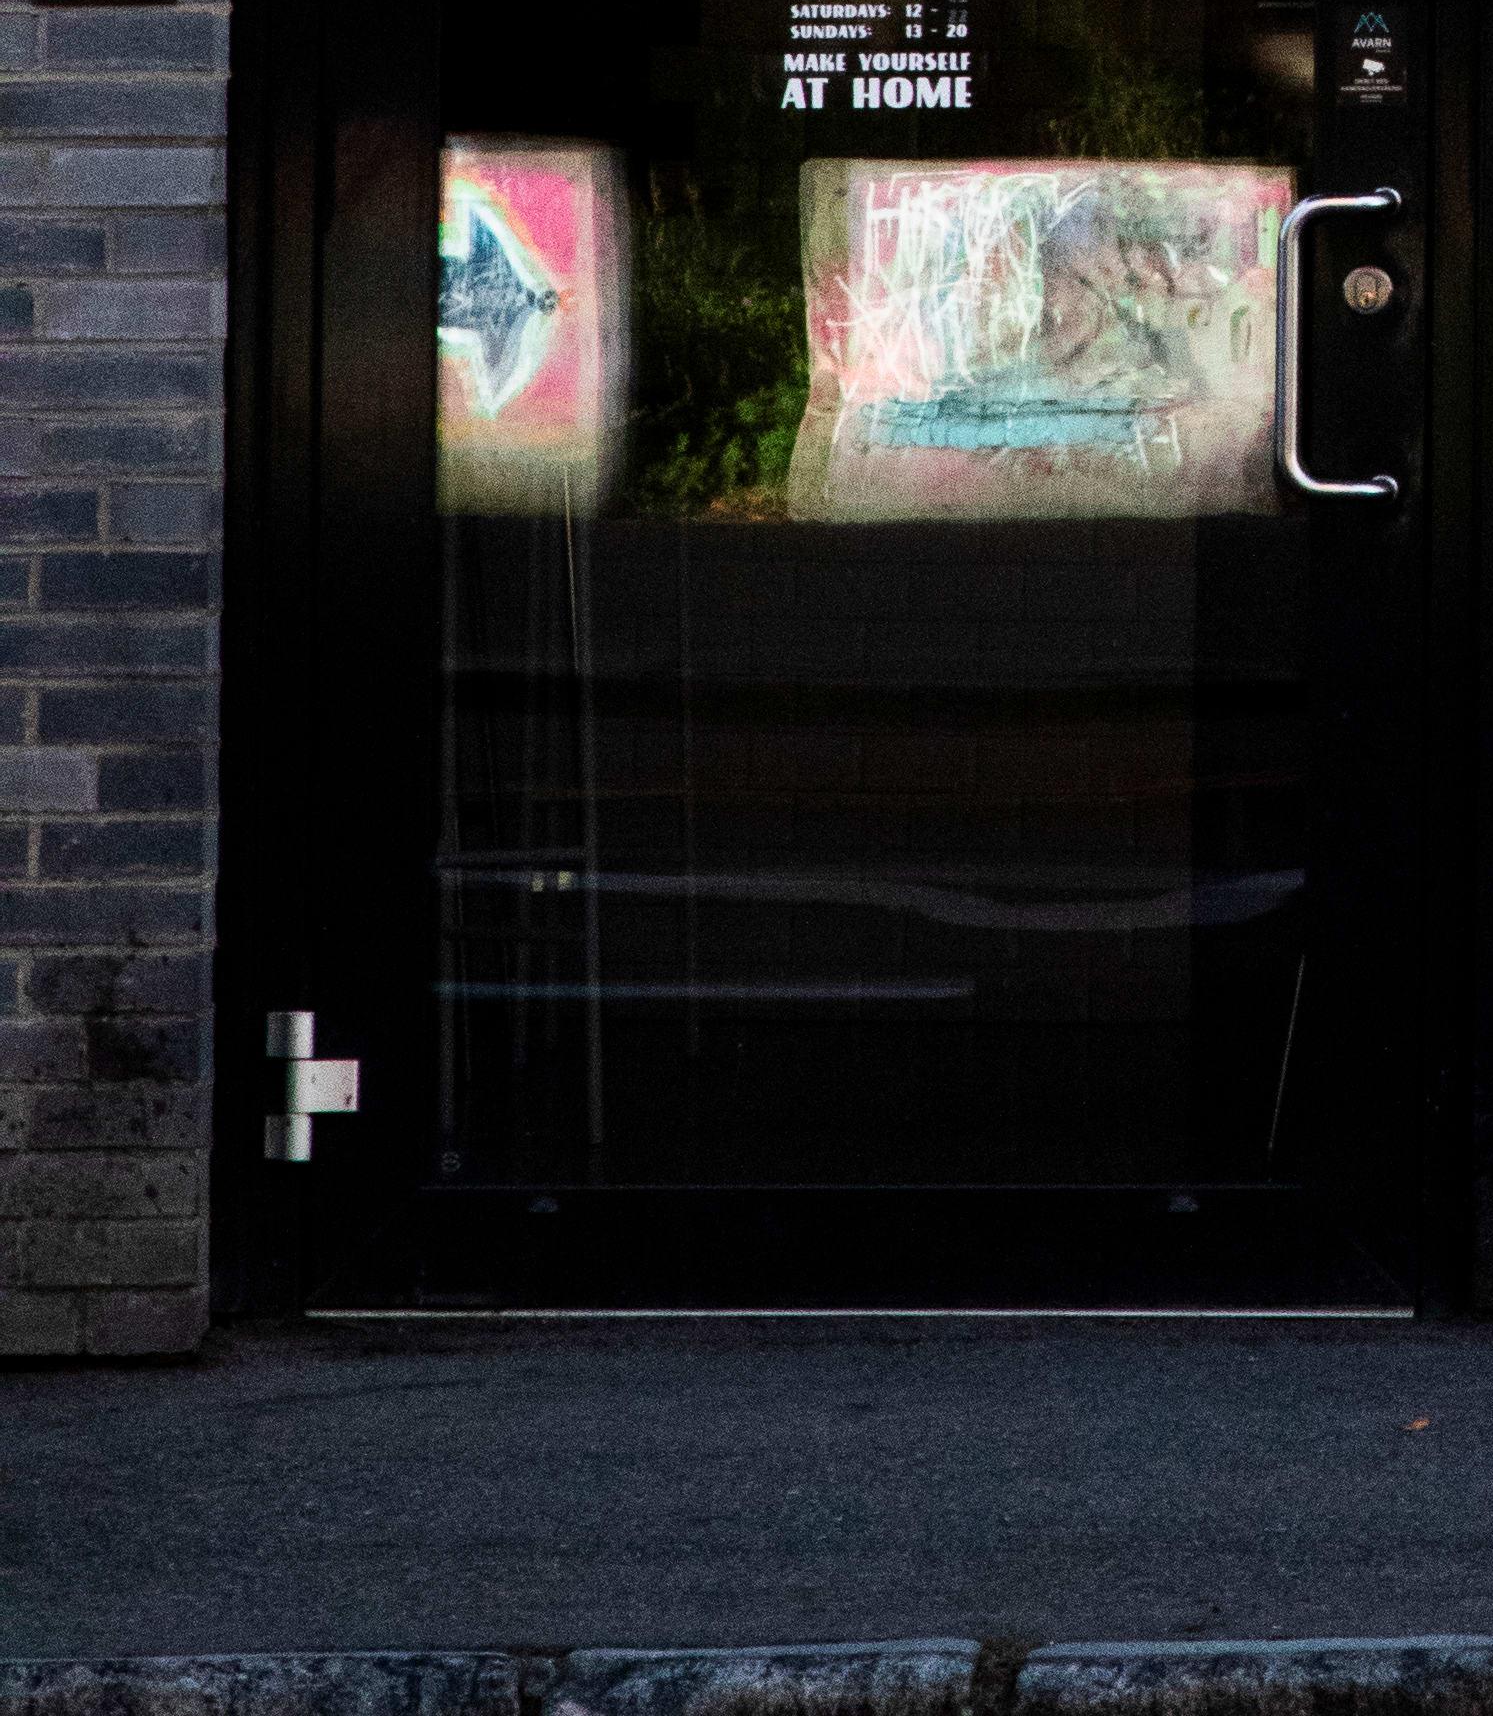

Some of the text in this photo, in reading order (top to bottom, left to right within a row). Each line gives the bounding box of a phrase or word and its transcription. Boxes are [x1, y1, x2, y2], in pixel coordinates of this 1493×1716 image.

[790, 4, 891, 18] SATURDAYS:
[905, 4, 922, 18] 12
[790, 25, 872, 38] SUNDAYS:
[905, 25, 922, 38] 13
[946, 25, 968, 38] 20
[1351, 37, 1393, 49] AVARN
[784, 52, 971, 72] MAKE YOURSELF
[781, 77, 972, 109] AT HOME
